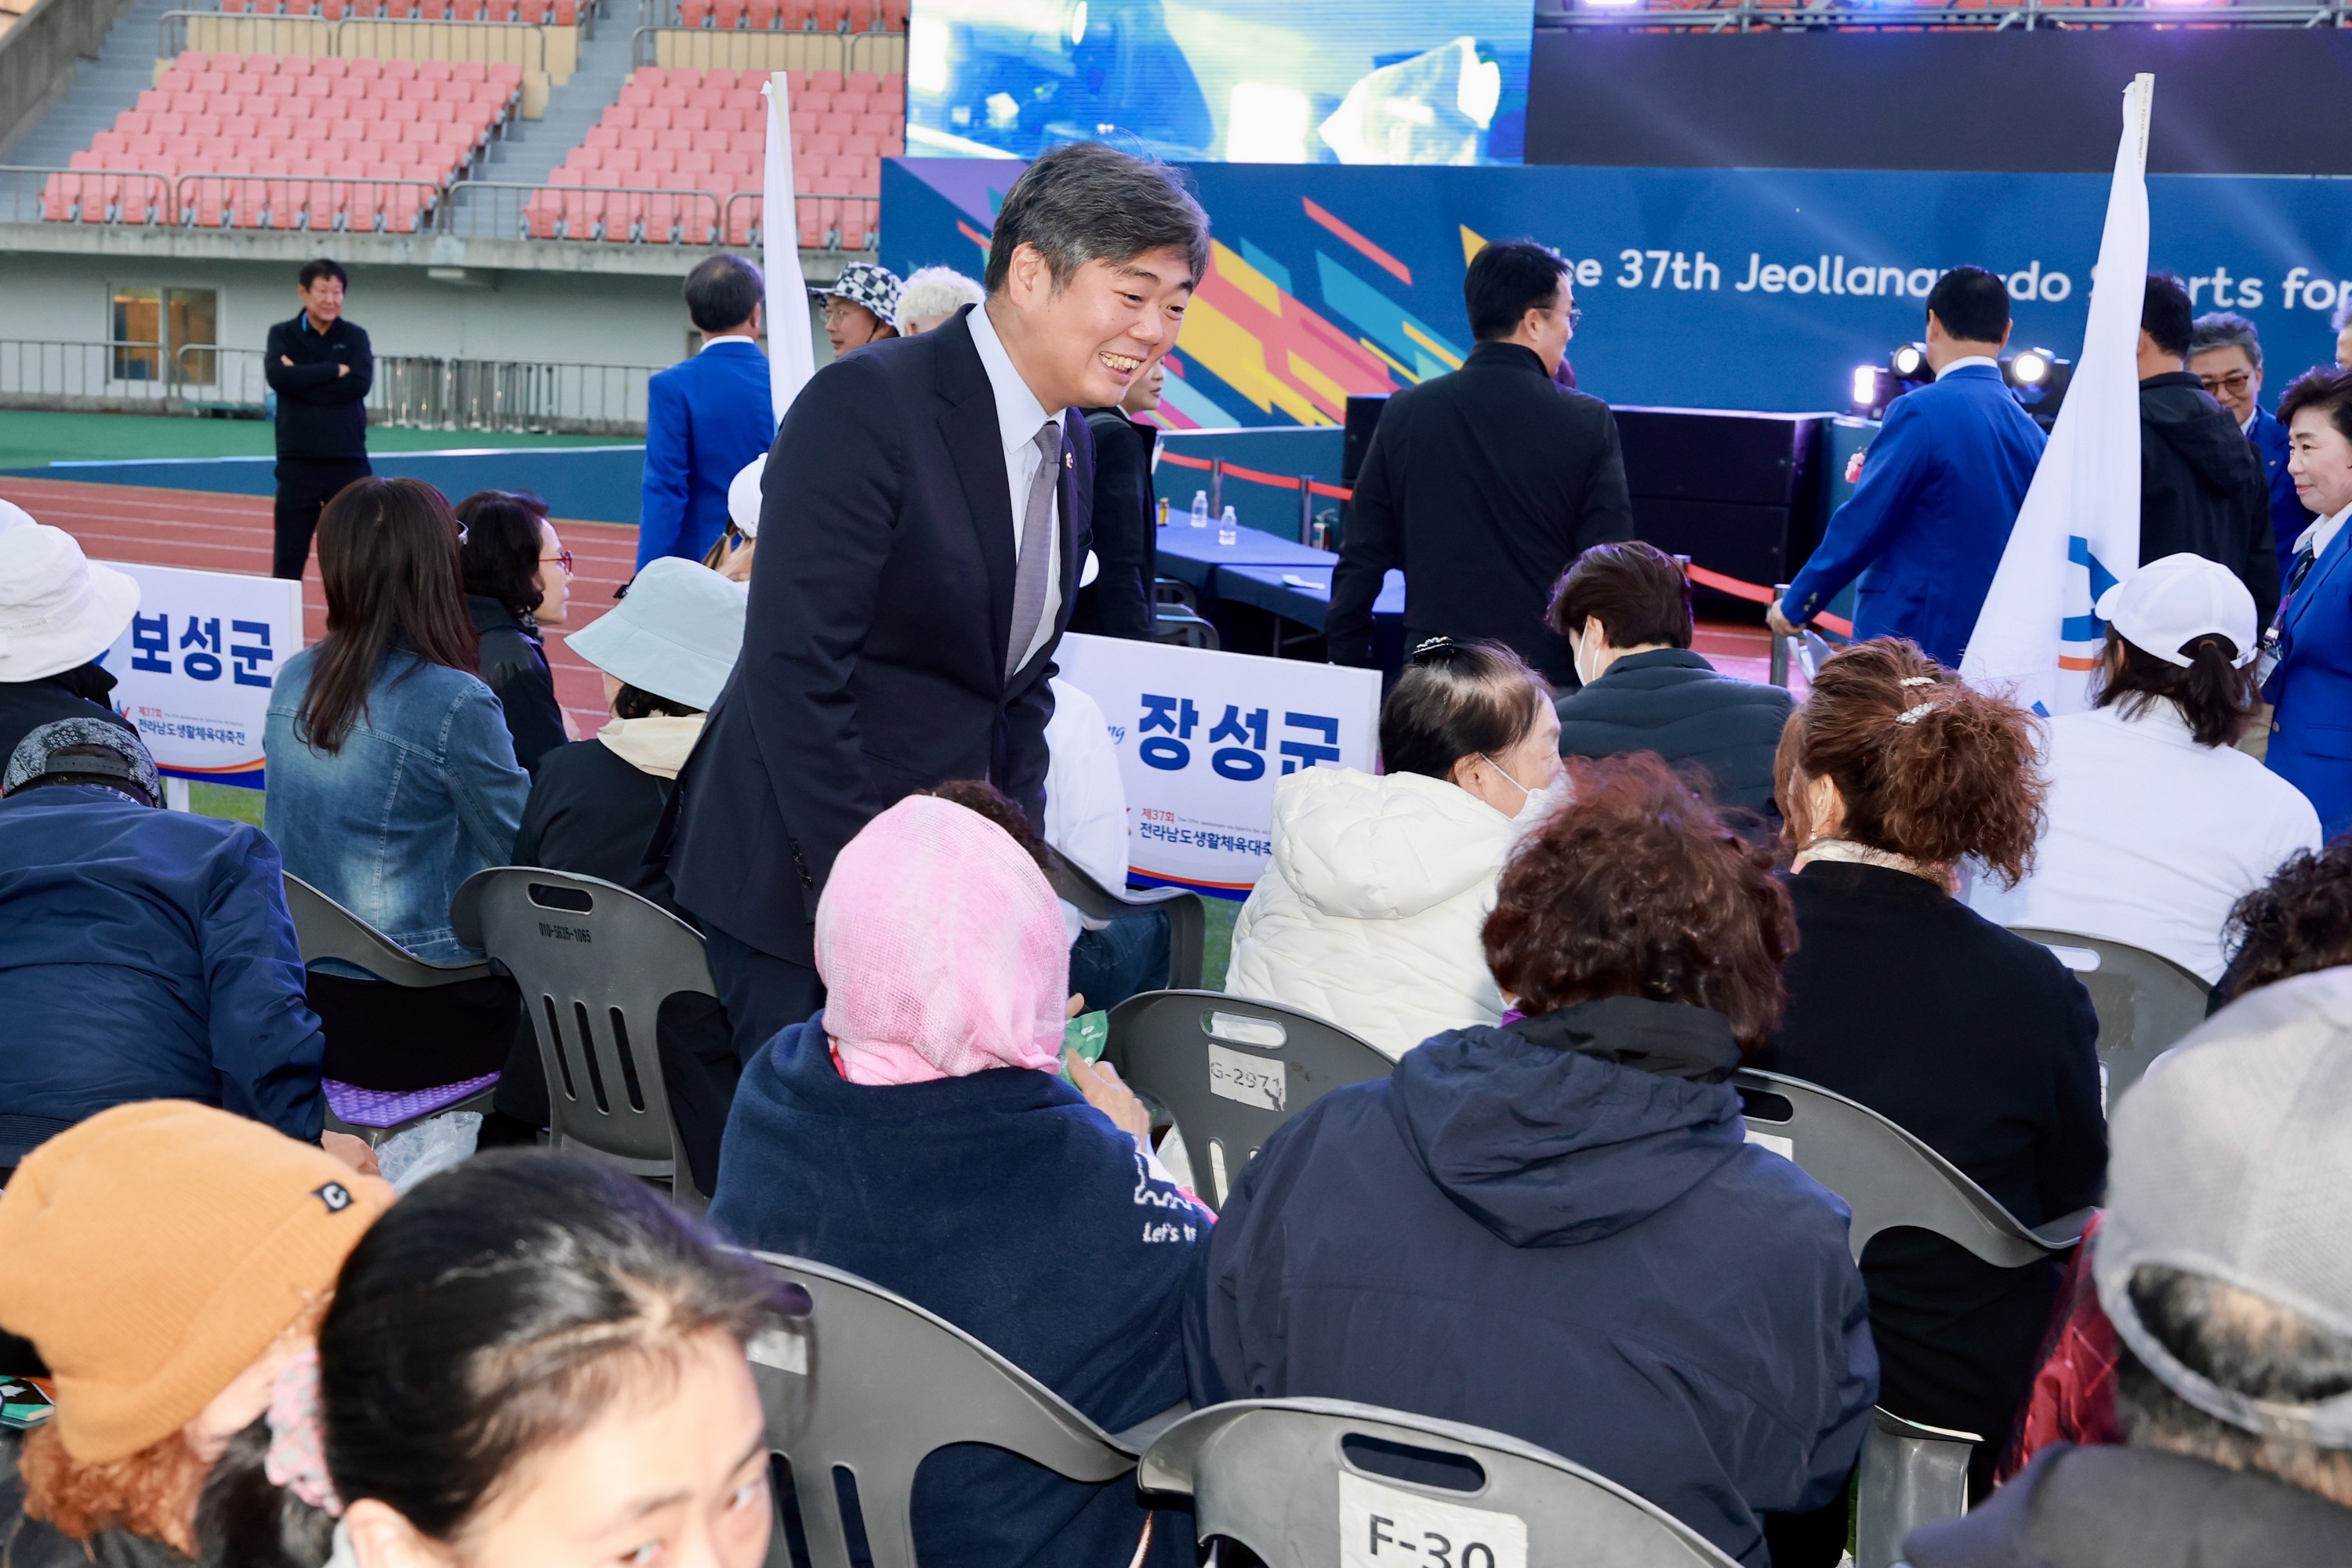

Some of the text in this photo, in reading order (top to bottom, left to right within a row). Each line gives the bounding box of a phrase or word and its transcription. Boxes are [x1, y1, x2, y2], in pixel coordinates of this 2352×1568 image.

[1617, 249, 1721, 291] 37th
[1734, 252, 2072, 303] Jeollana-do
[132, 611, 273, 688] 보성군
[137, 718, 245, 746] 전라남도생활체육대축전
[1138, 693, 1341, 782] 장성군
[1142, 808, 1175, 823] 제37회
[1139, 822, 1272, 857] 전라남도생활체육대축
[1142, 1221, 1180, 1243] Let's
[1370, 1513, 1495, 1568] F-30
